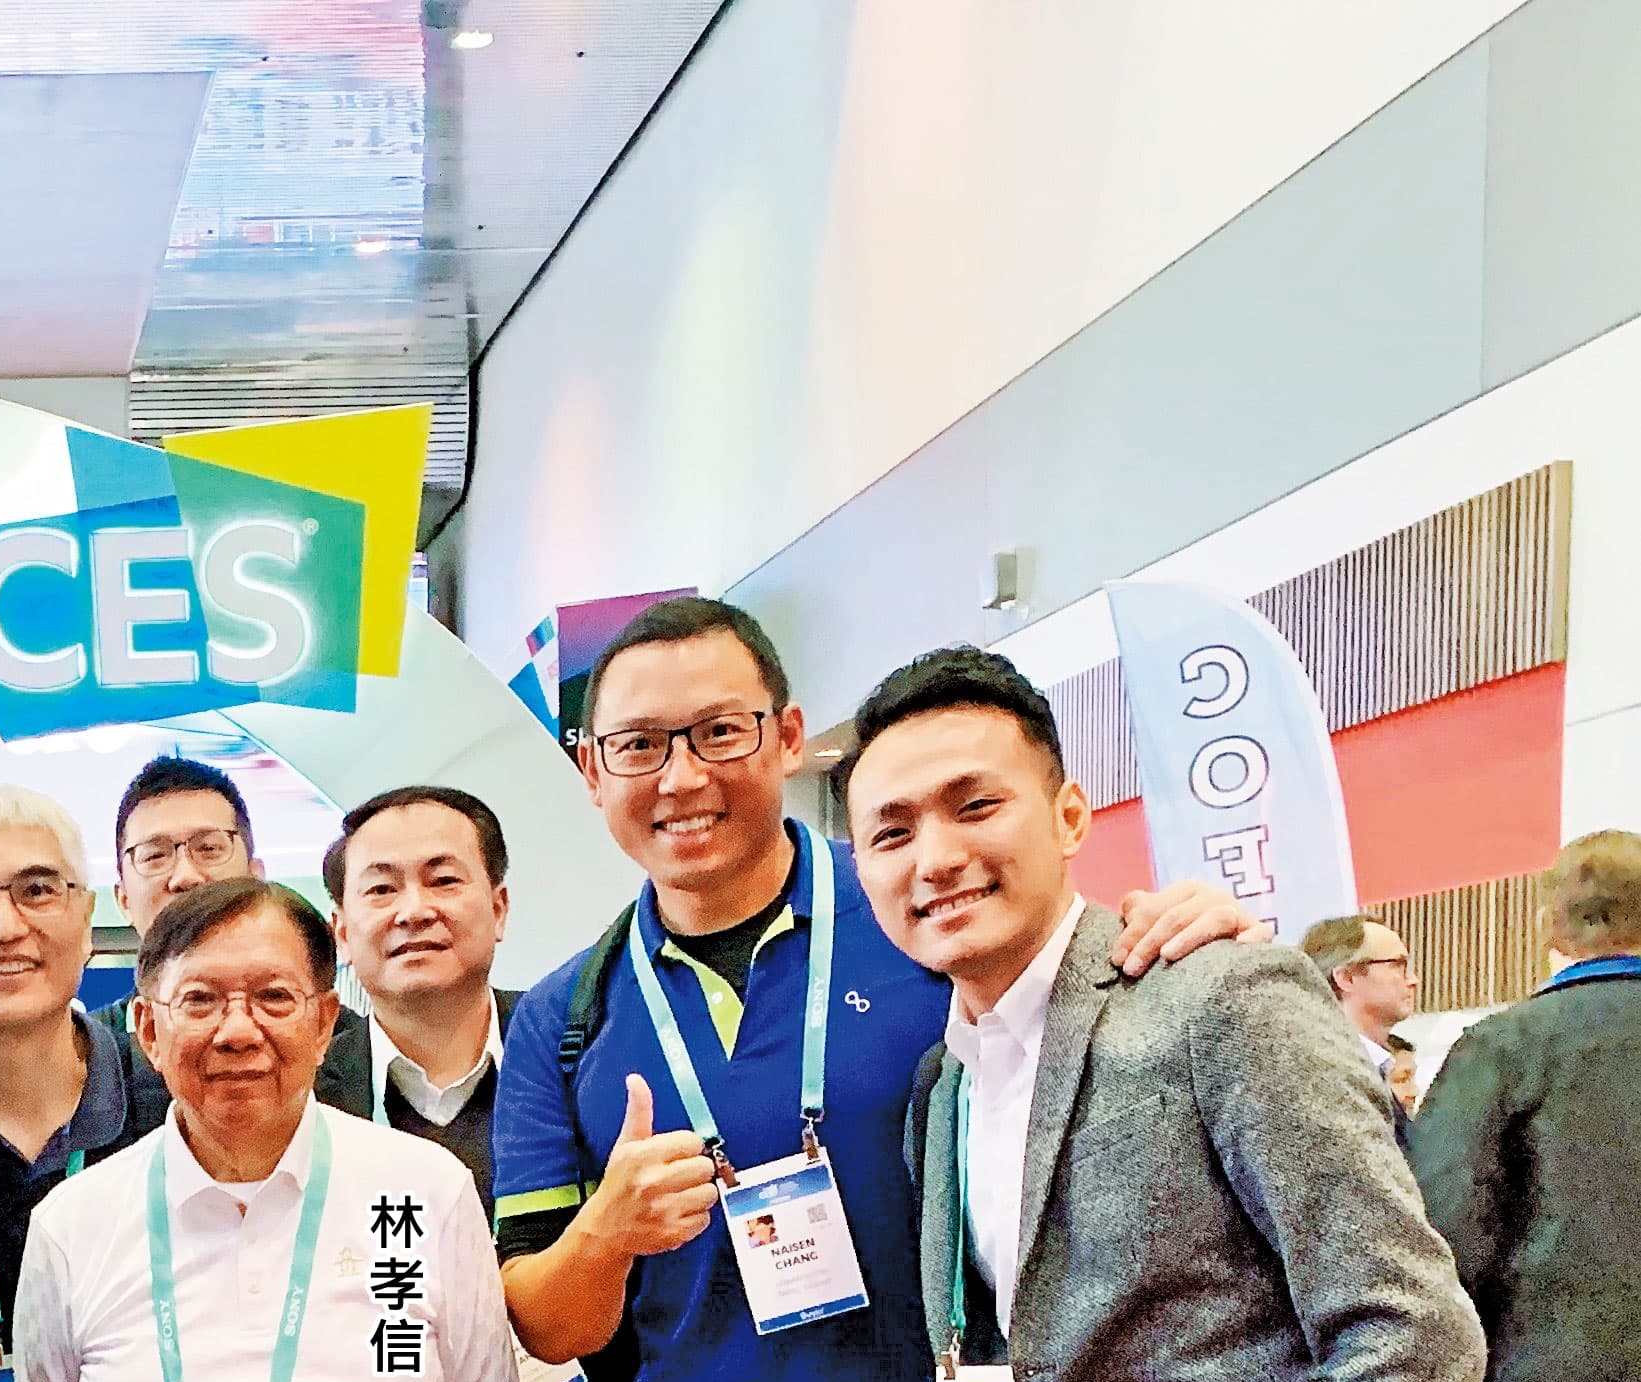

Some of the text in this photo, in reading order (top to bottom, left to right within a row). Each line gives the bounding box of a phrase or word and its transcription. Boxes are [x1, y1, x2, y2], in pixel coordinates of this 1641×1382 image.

[771, 1238, 816, 1257] NAISEN
[776, 1251, 819, 1270] CHANG
[160, 1300, 173, 1350] SONY
[284, 1286, 304, 1336] SONY
